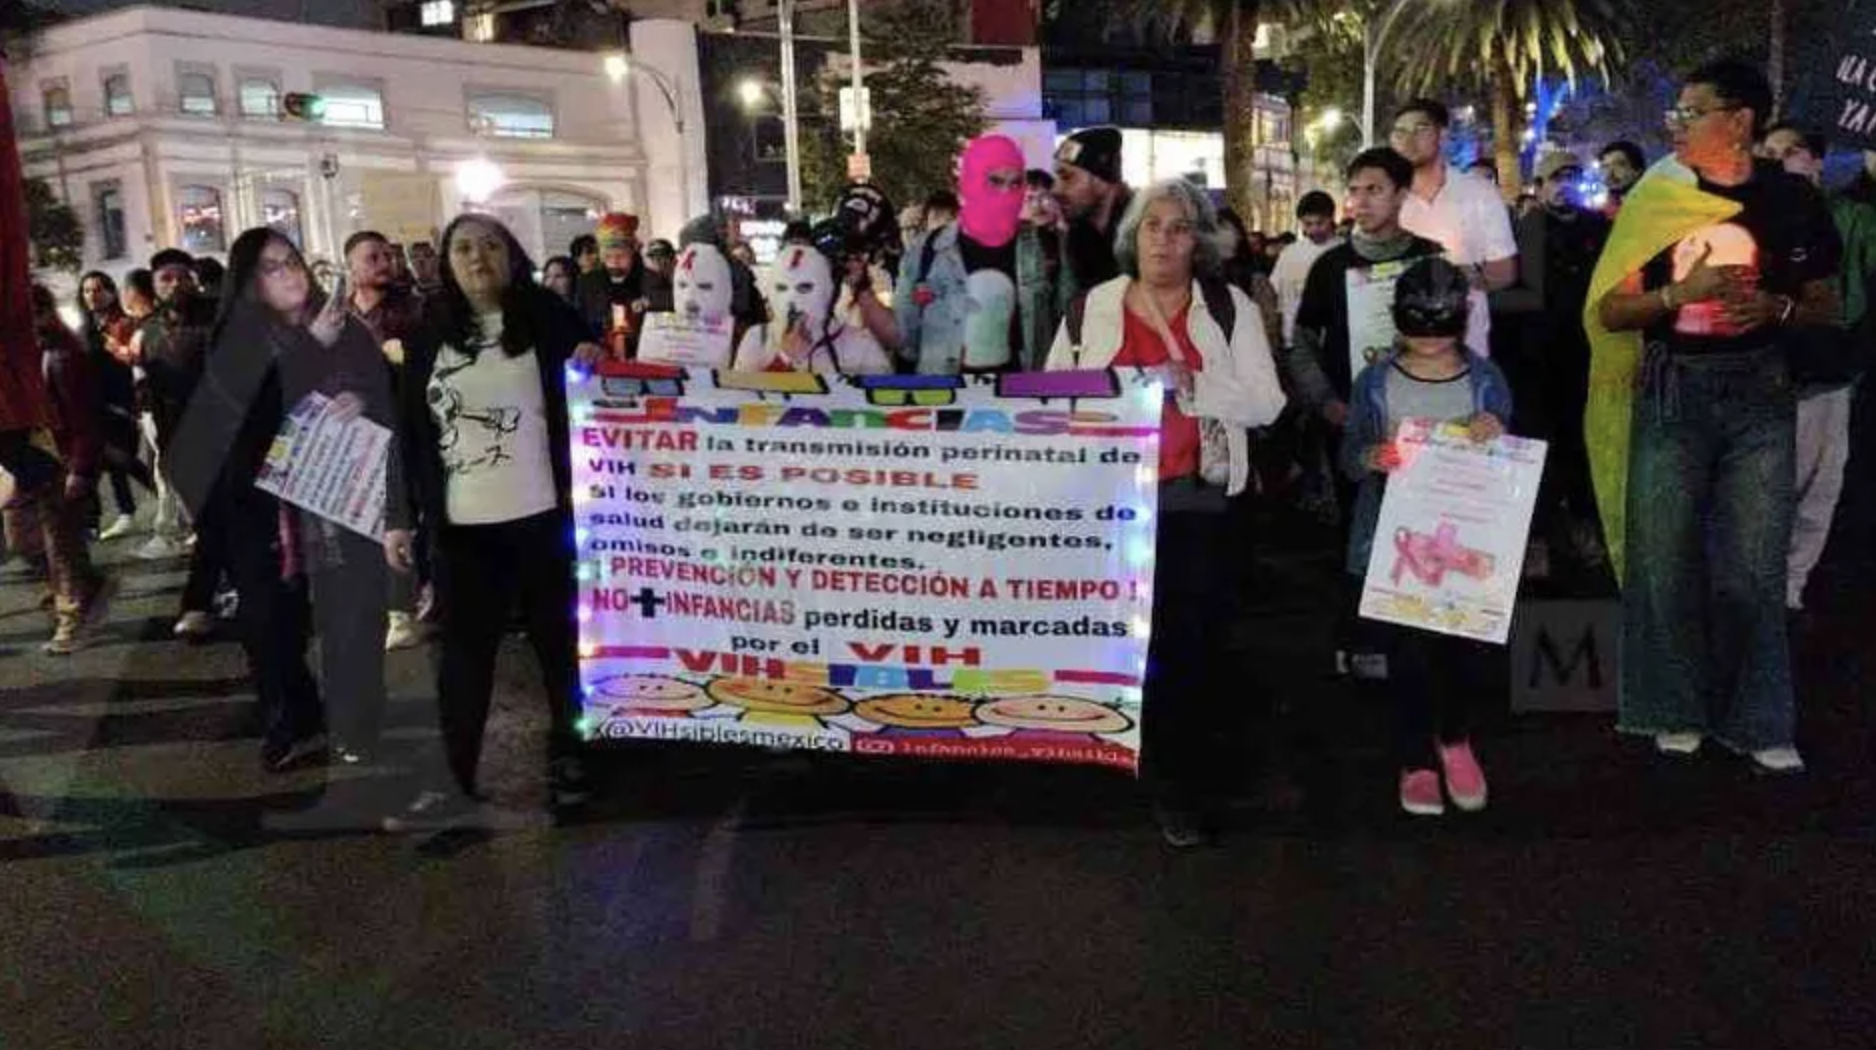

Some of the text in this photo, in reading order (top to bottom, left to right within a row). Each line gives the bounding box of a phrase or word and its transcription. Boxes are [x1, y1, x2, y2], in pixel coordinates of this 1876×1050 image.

[583, 427, 1141, 464] EVITAR la transmisión perinatal de
[588, 458, 980, 490] VIH SI ES POSIBLE
[626, 487, 666, 503] los
[675, 490, 830, 511] gobiernos
[842, 501, 860, 512] e
[872, 496, 1084, 521] instituciones
[1095, 504, 1137, 521] de
[589, 510, 665, 529] salud
[801, 521, 837, 539] de
[849, 526, 898, 541] ser
[906, 527, 1113, 551] negligentes,
[590, 537, 691, 557] omisos
[702, 547, 717, 559] e
[785, 569, 802, 588] Y
[812, 569, 968, 598] DETECCIÓN
[979, 578, 998, 599] A
[1006, 578, 1120, 601] TIEMPO
[803, 608, 933, 633] perdidas
[943, 617, 960, 638] y
[970, 614, 1128, 638] marcadas
[731, 635, 981, 666] por el VIH
[1528, 621, 1603, 691] M
